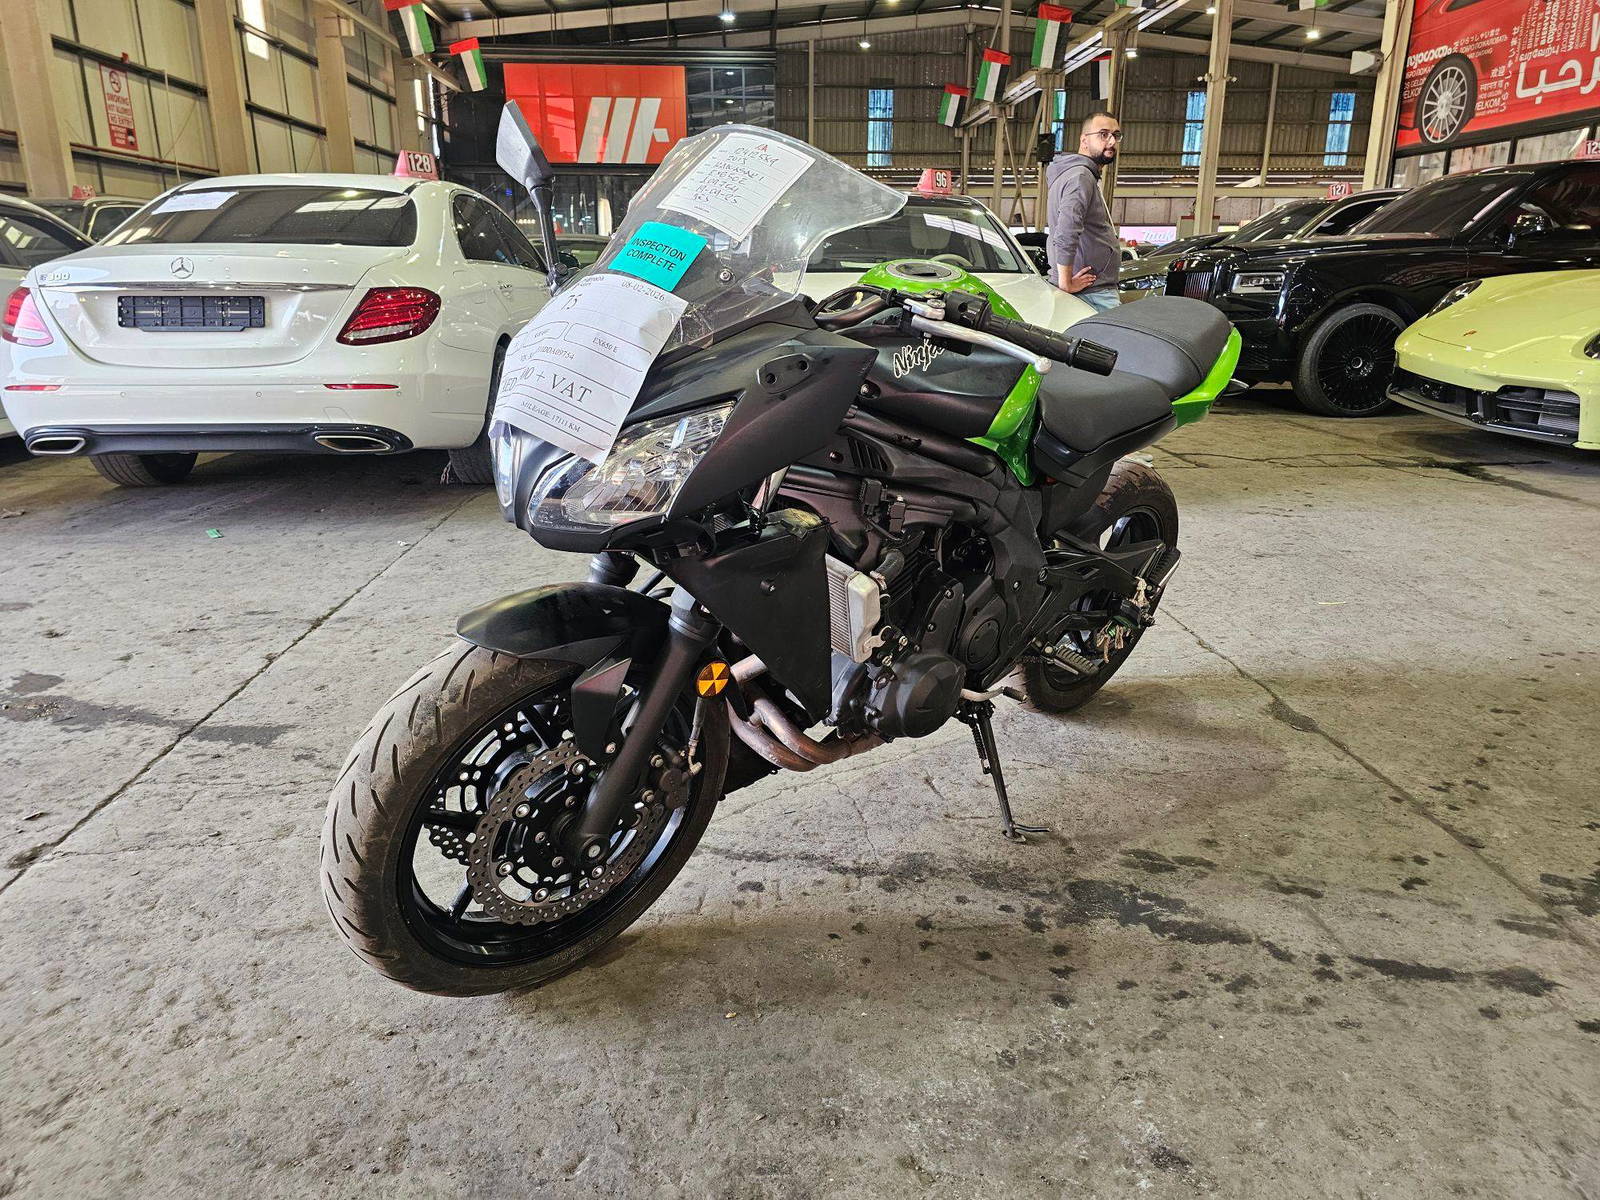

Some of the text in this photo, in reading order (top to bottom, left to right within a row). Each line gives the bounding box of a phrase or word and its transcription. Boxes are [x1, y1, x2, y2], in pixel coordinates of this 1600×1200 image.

[1516, 56, 1600, 105] رحبا
[1587, 142, 1600, 155] 12
[407, 153, 432, 174] 128
[935, 171, 947, 188] 96
[1331, 184, 1346, 197] 127
[626, 248, 677, 272] COMPLETE
[630, 236, 687, 263] INSPECTION
[621, 279, 666, 302] 08-02-2026
[892, 338, 946, 379] Ninja
[550, 373, 592, 403] VAT
